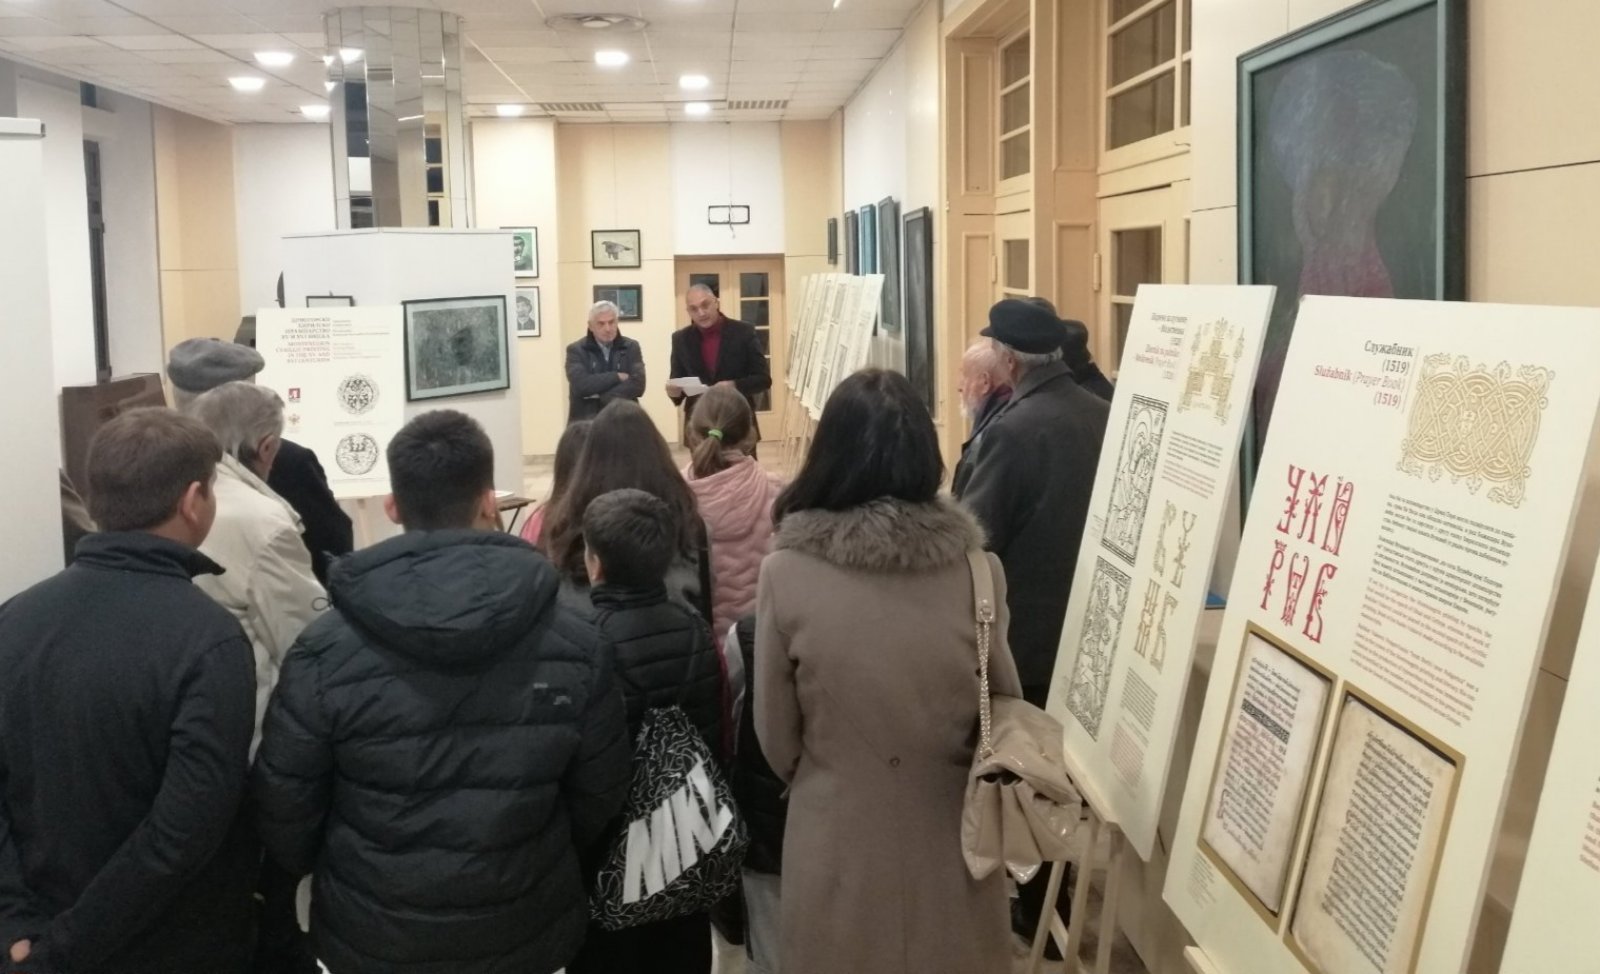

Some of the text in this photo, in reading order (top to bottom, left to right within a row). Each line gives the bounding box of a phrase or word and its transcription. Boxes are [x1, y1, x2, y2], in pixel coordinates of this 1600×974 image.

[1364, 340, 1414, 356] Служабник
[1382, 359, 1410, 376] (1519)
[1374, 392, 1401, 408] (1519)
